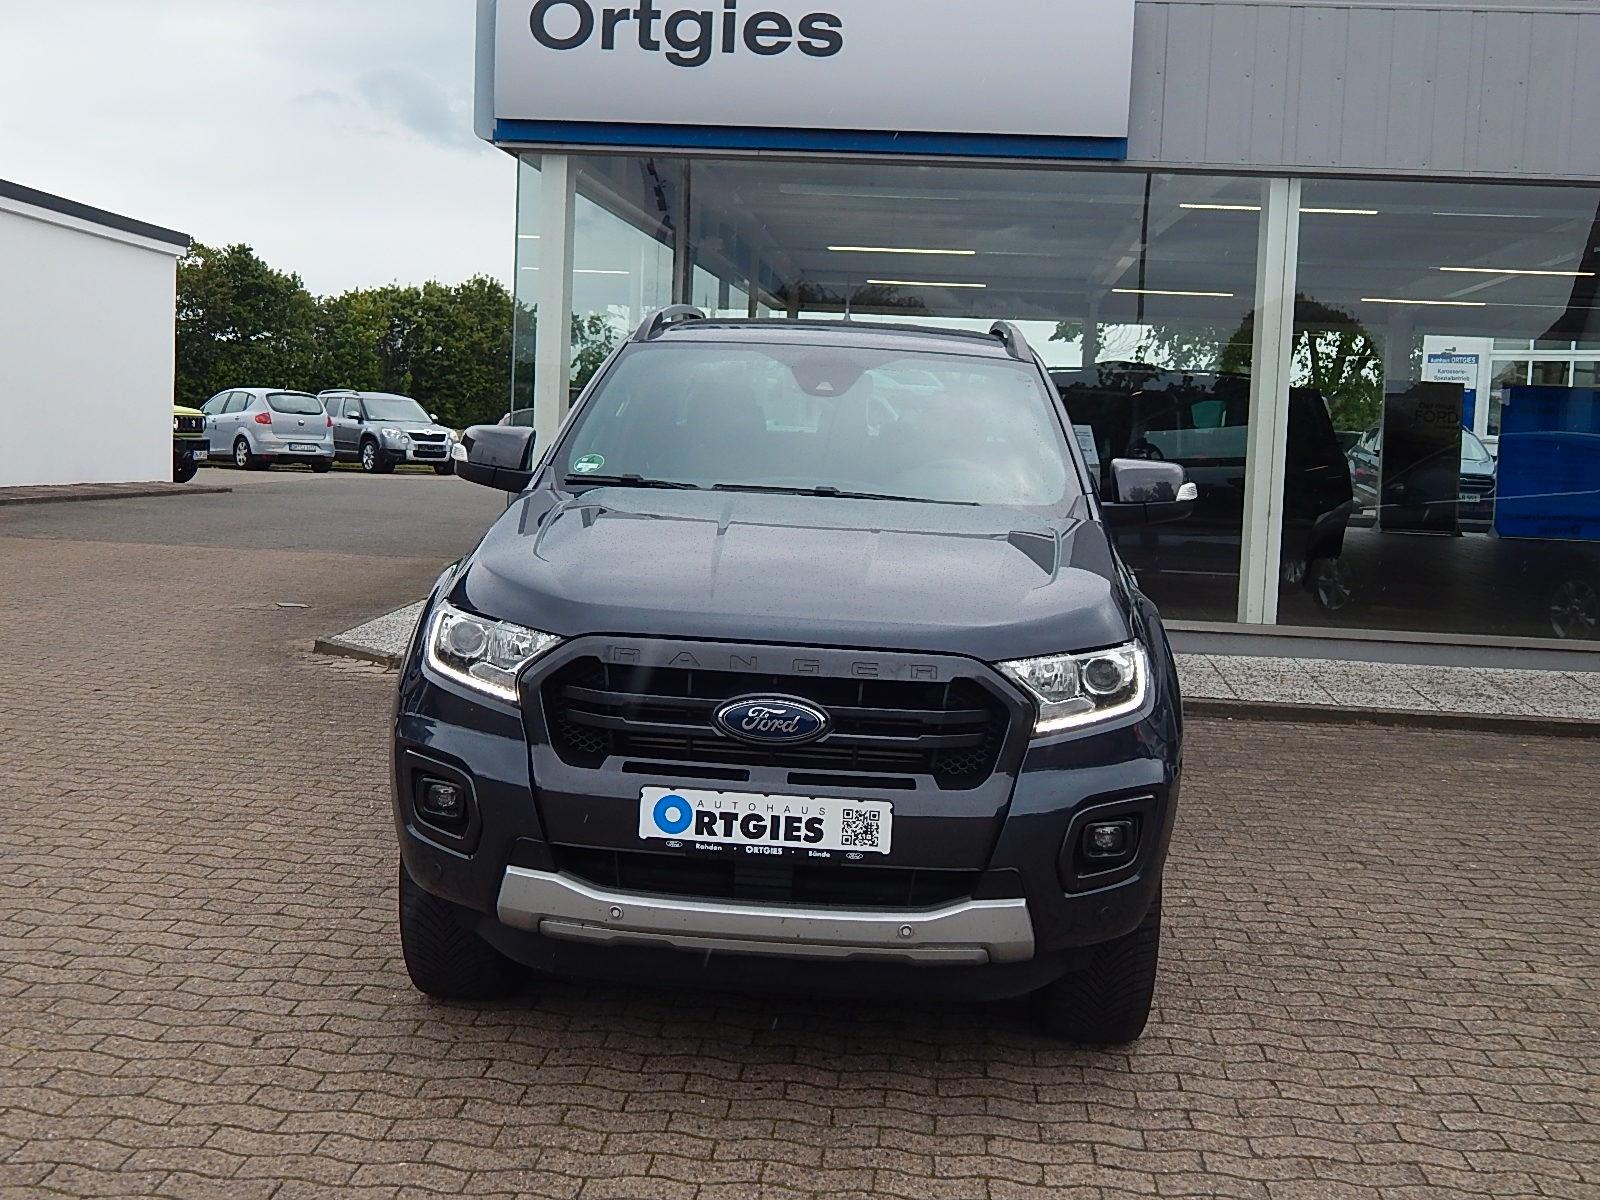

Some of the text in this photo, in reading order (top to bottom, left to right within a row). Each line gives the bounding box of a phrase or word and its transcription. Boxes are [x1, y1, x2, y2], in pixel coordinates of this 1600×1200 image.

[529, 0, 844, 67] Ortgies
[1451, 356, 1476, 364] ORTGIES
[1415, 410, 1459, 424] FORD
[613, 647, 938, 680] RANGER
[741, 706, 801, 732] Ford
[697, 800, 826, 816] AUTOHAUS
[653, 794, 825, 844] ORTGIES
[745, 846, 783, 855] ORTGIES
